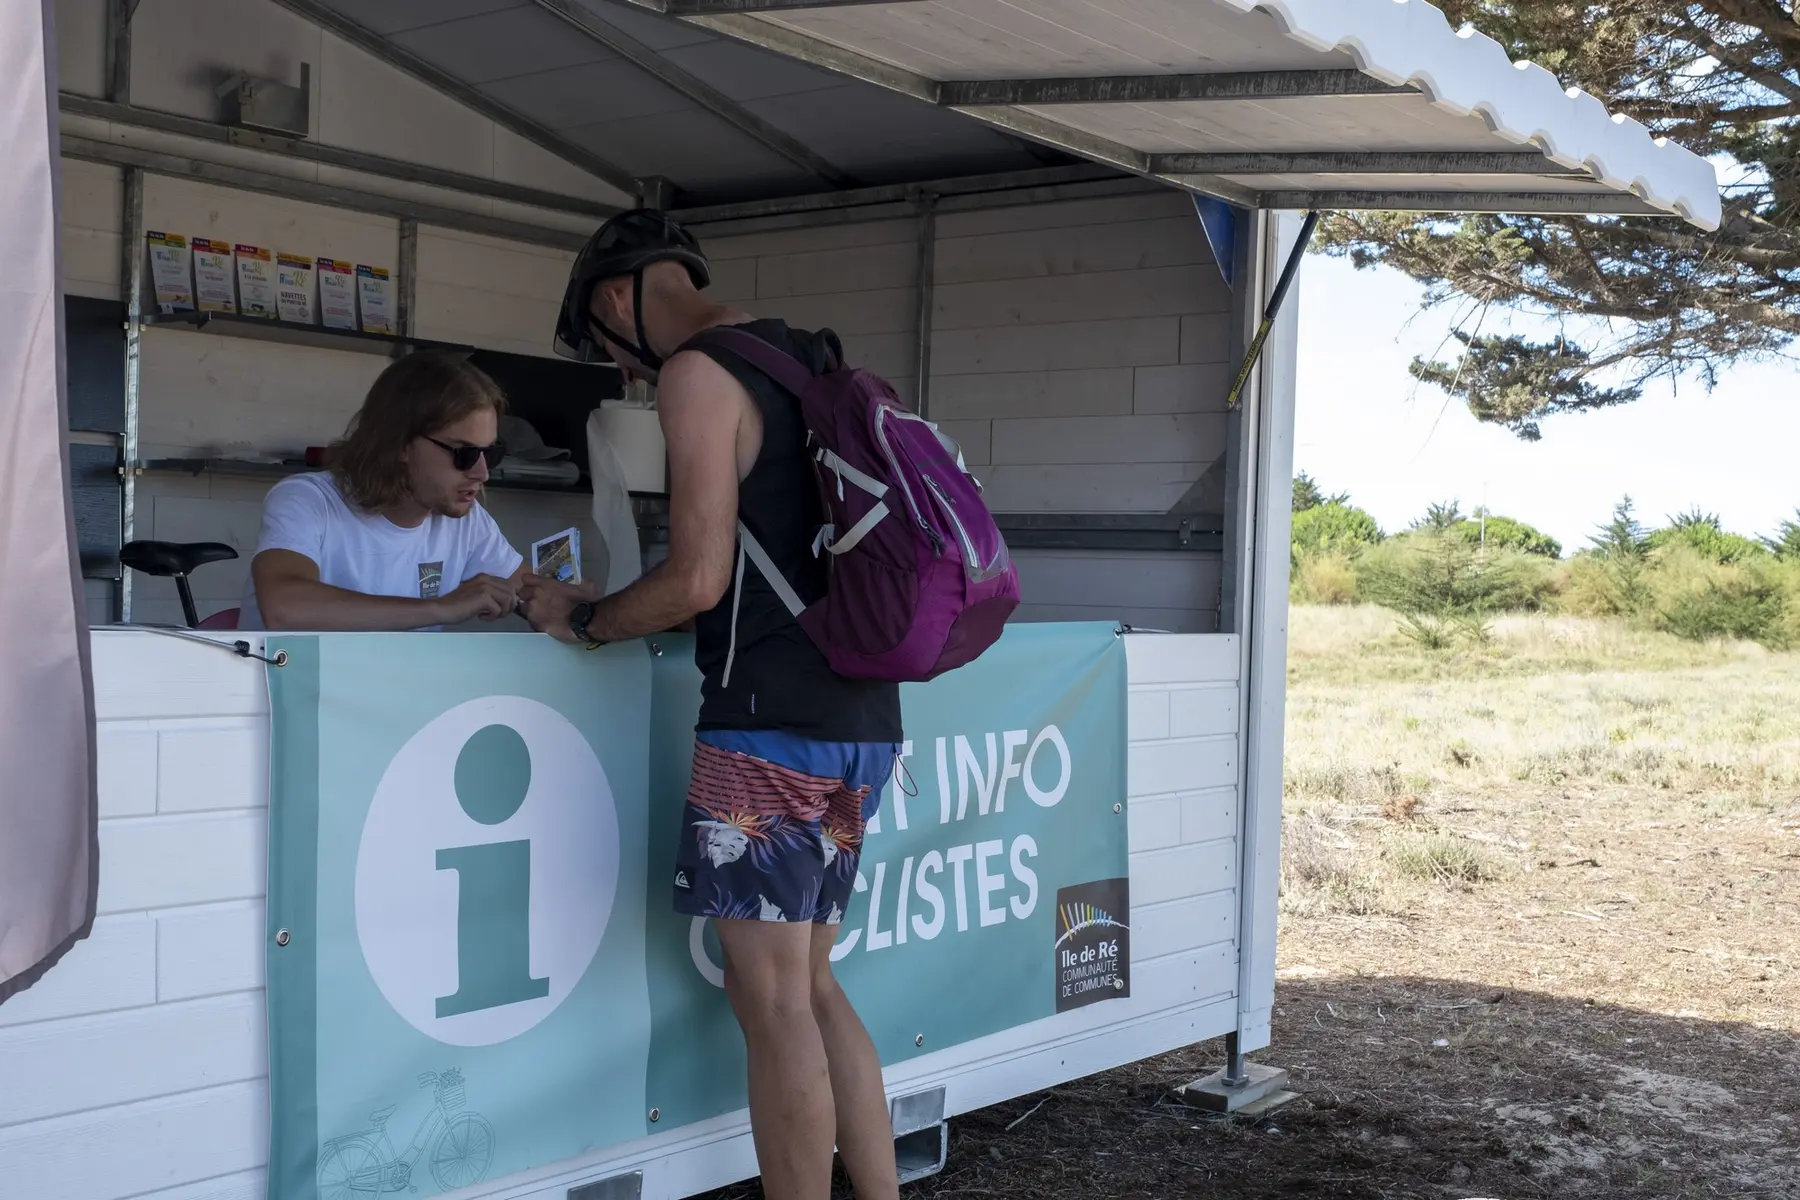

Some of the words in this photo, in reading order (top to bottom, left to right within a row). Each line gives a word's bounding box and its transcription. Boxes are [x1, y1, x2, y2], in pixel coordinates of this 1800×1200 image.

[281, 291, 307, 301] NAVETTES
[935, 724, 1072, 824] INFO
[688, 833, 1039, 989] CLISTES
[1061, 949, 1078, 968] Ile
[1080, 945, 1096, 963] de
[1098, 939, 1119, 960] Ré
[1062, 958, 1118, 983] COMMUNAUTÉ
[1062, 985, 1072, 997] DE
[1074, 973, 1119, 994] COMMUNES
